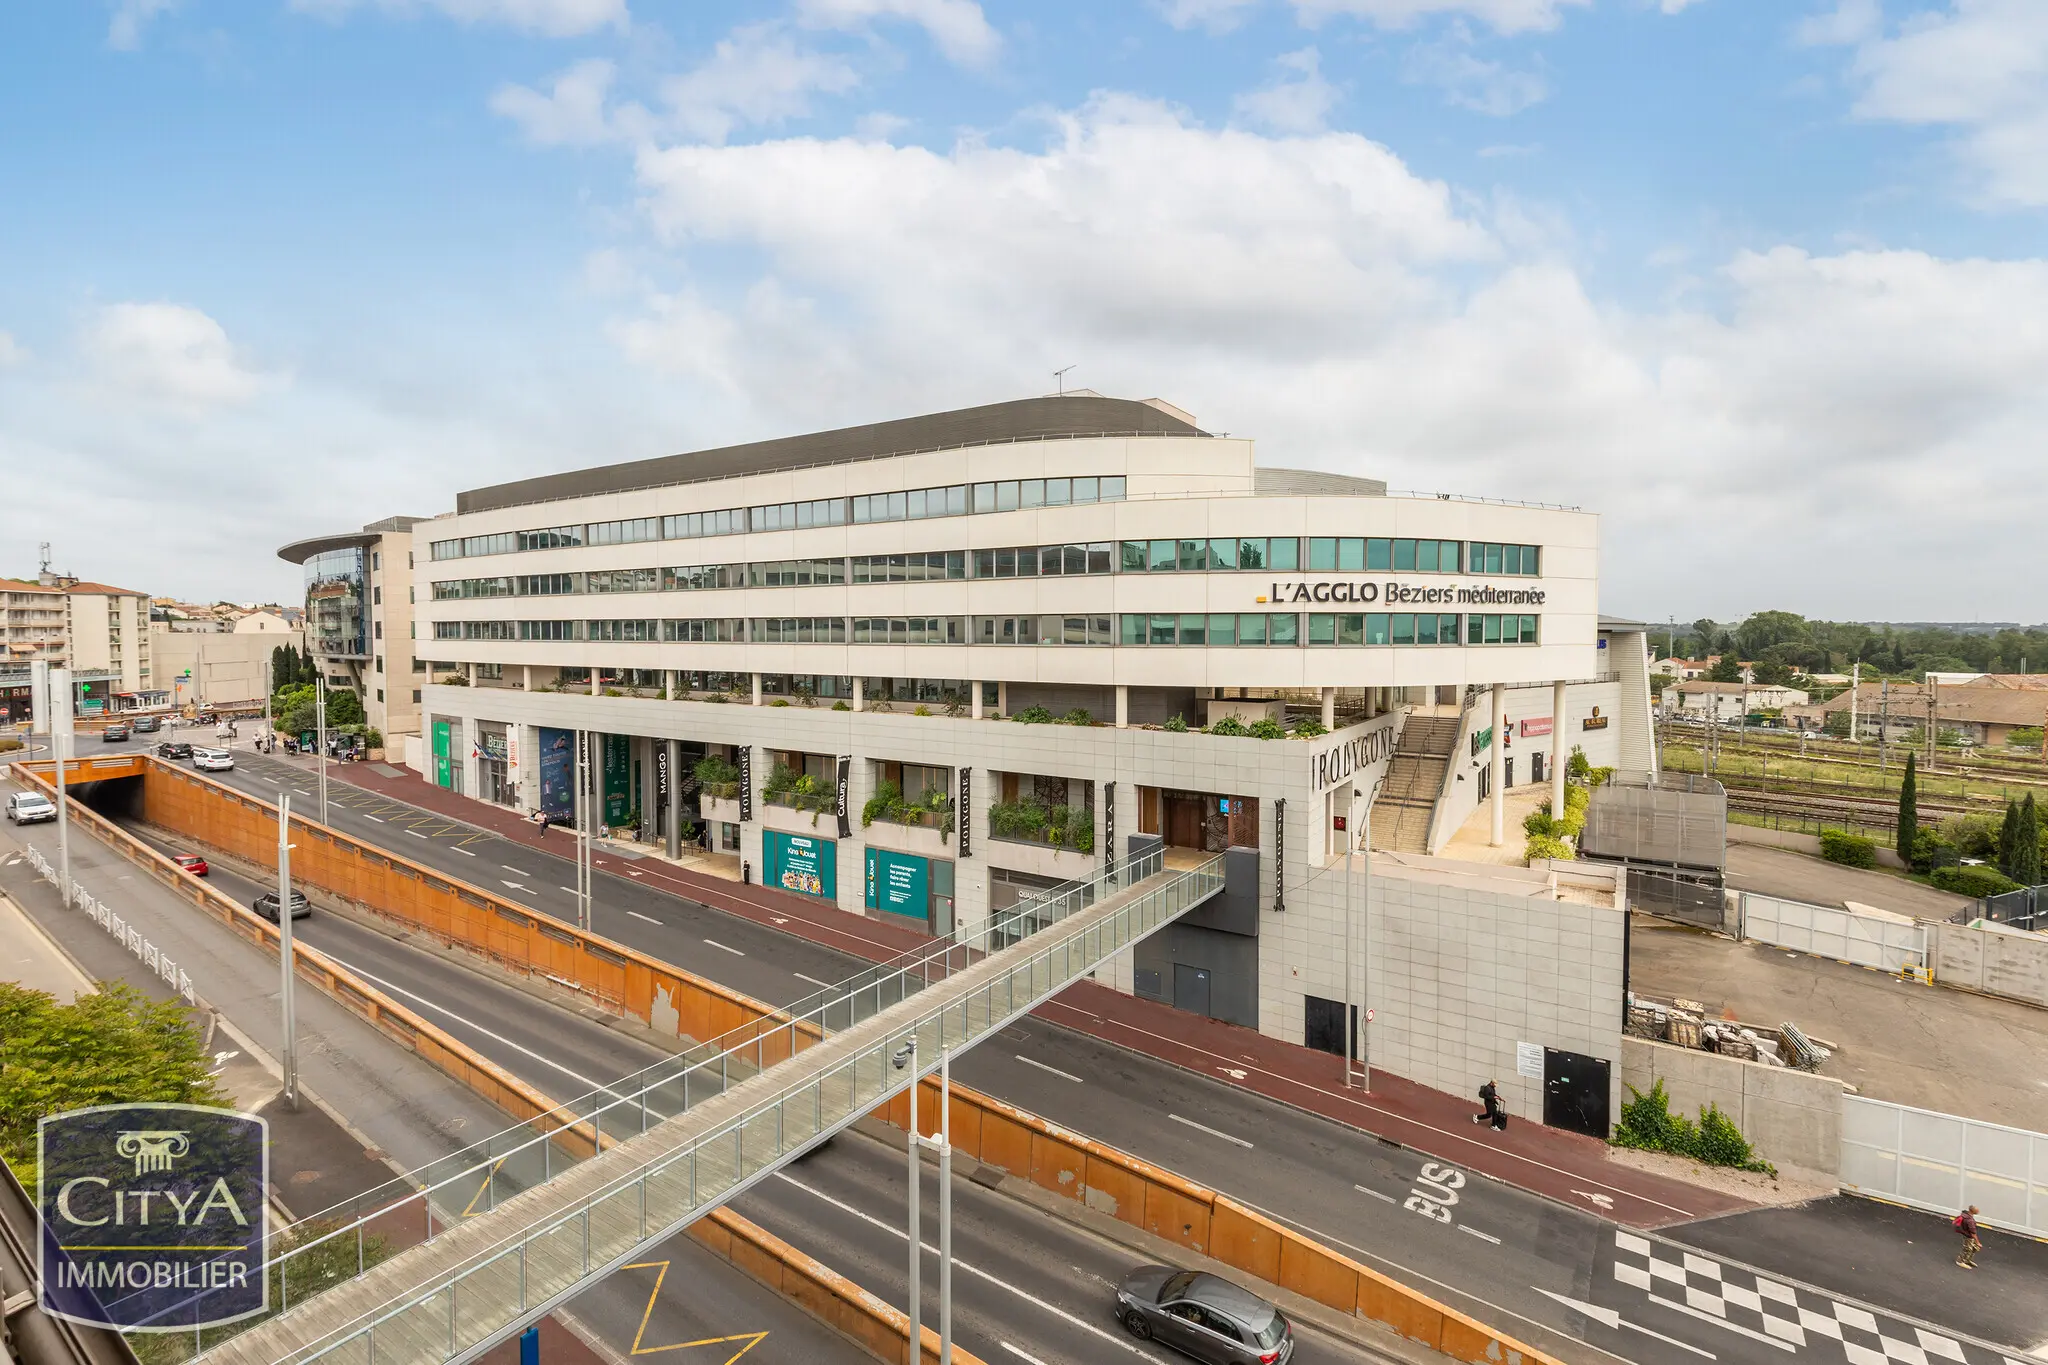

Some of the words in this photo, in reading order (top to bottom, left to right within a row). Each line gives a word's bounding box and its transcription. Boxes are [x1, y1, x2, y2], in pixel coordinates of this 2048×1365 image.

[1272, 583, 1379, 603] L'AGGLO
[1385, 582, 1453, 604] Béziers
[1458, 584, 1546, 605] méditerranée
[658, 753, 667, 794] MANGO
[741, 754, 750, 813] POLYGONE
[837, 778, 848, 817] Cultura
[1403, 1162, 1466, 1224] BUS
